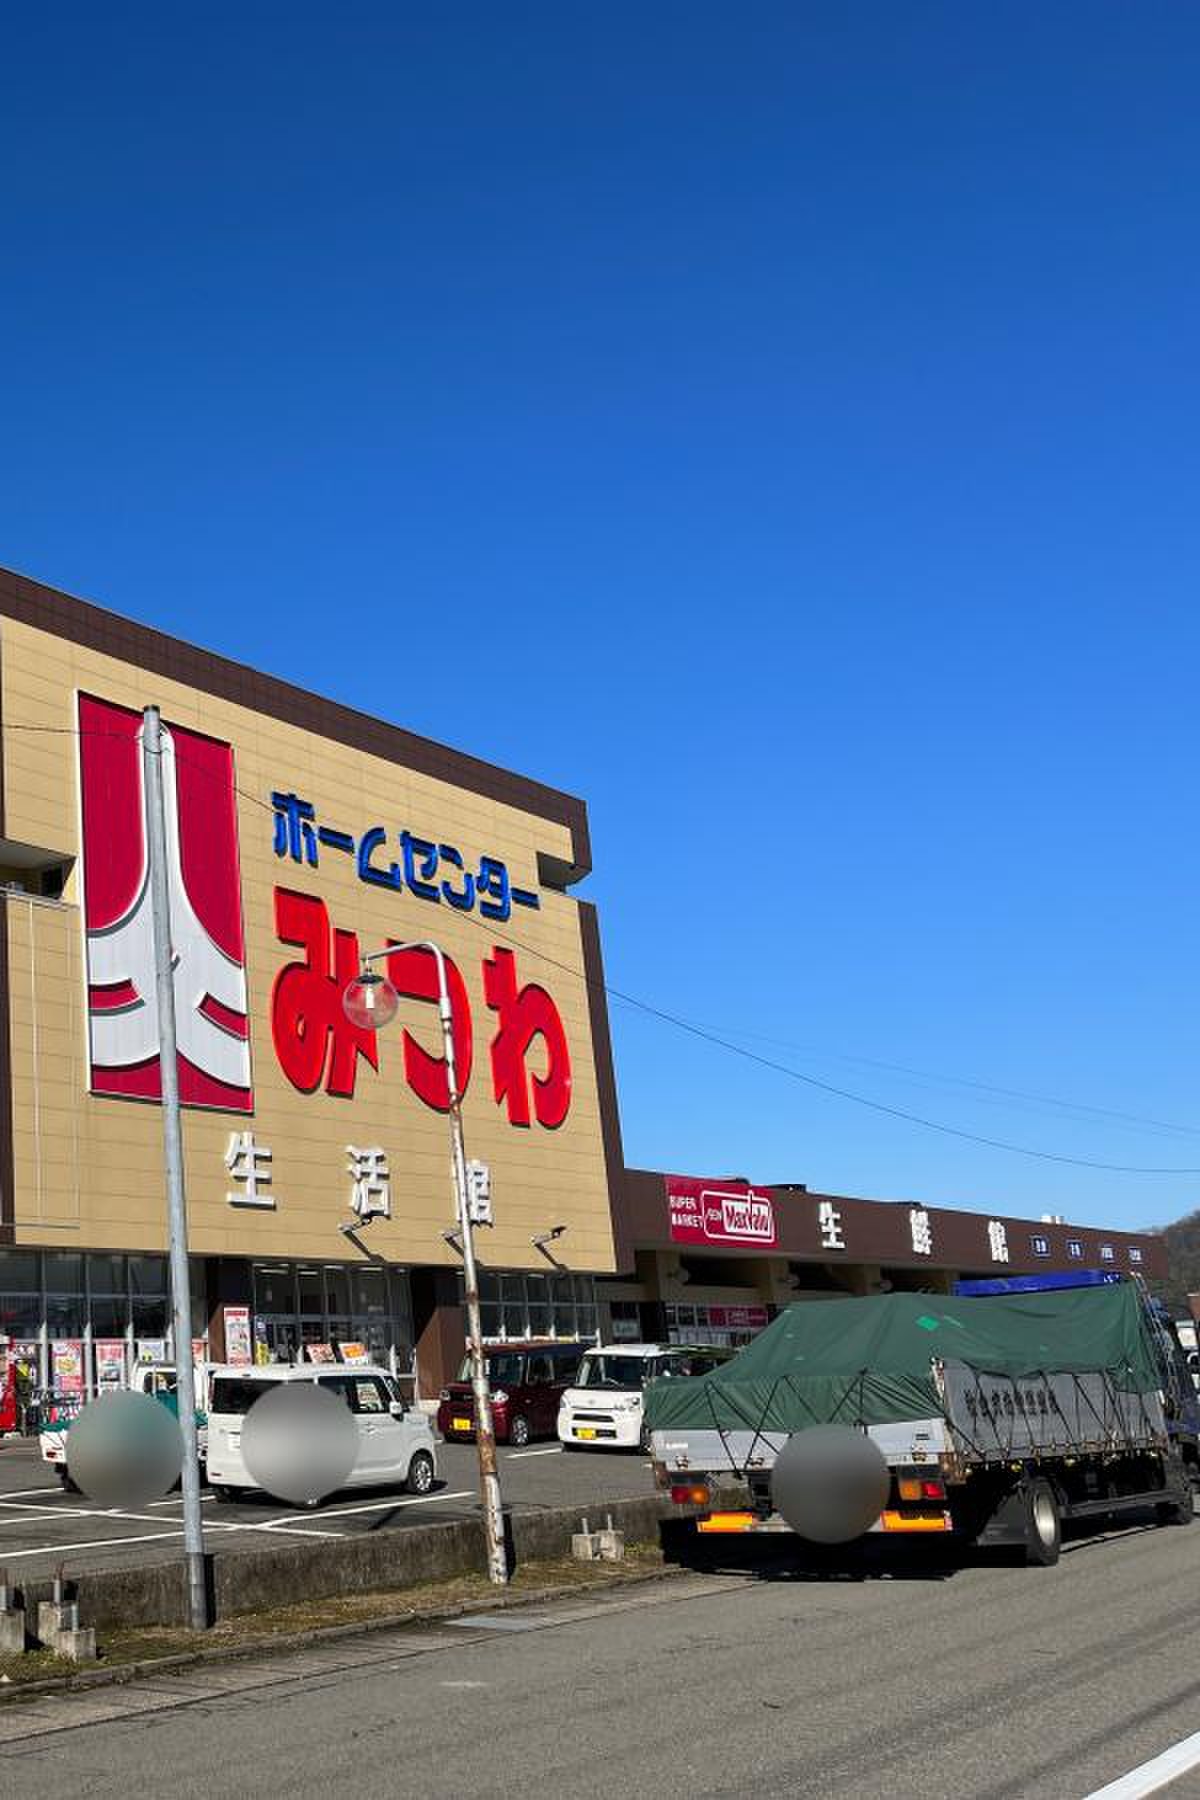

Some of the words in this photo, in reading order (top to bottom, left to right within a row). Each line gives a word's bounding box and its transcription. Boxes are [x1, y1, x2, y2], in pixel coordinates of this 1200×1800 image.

[270, 790, 541, 922] ホームセンター
[271, 885, 572, 1130] みつわ
